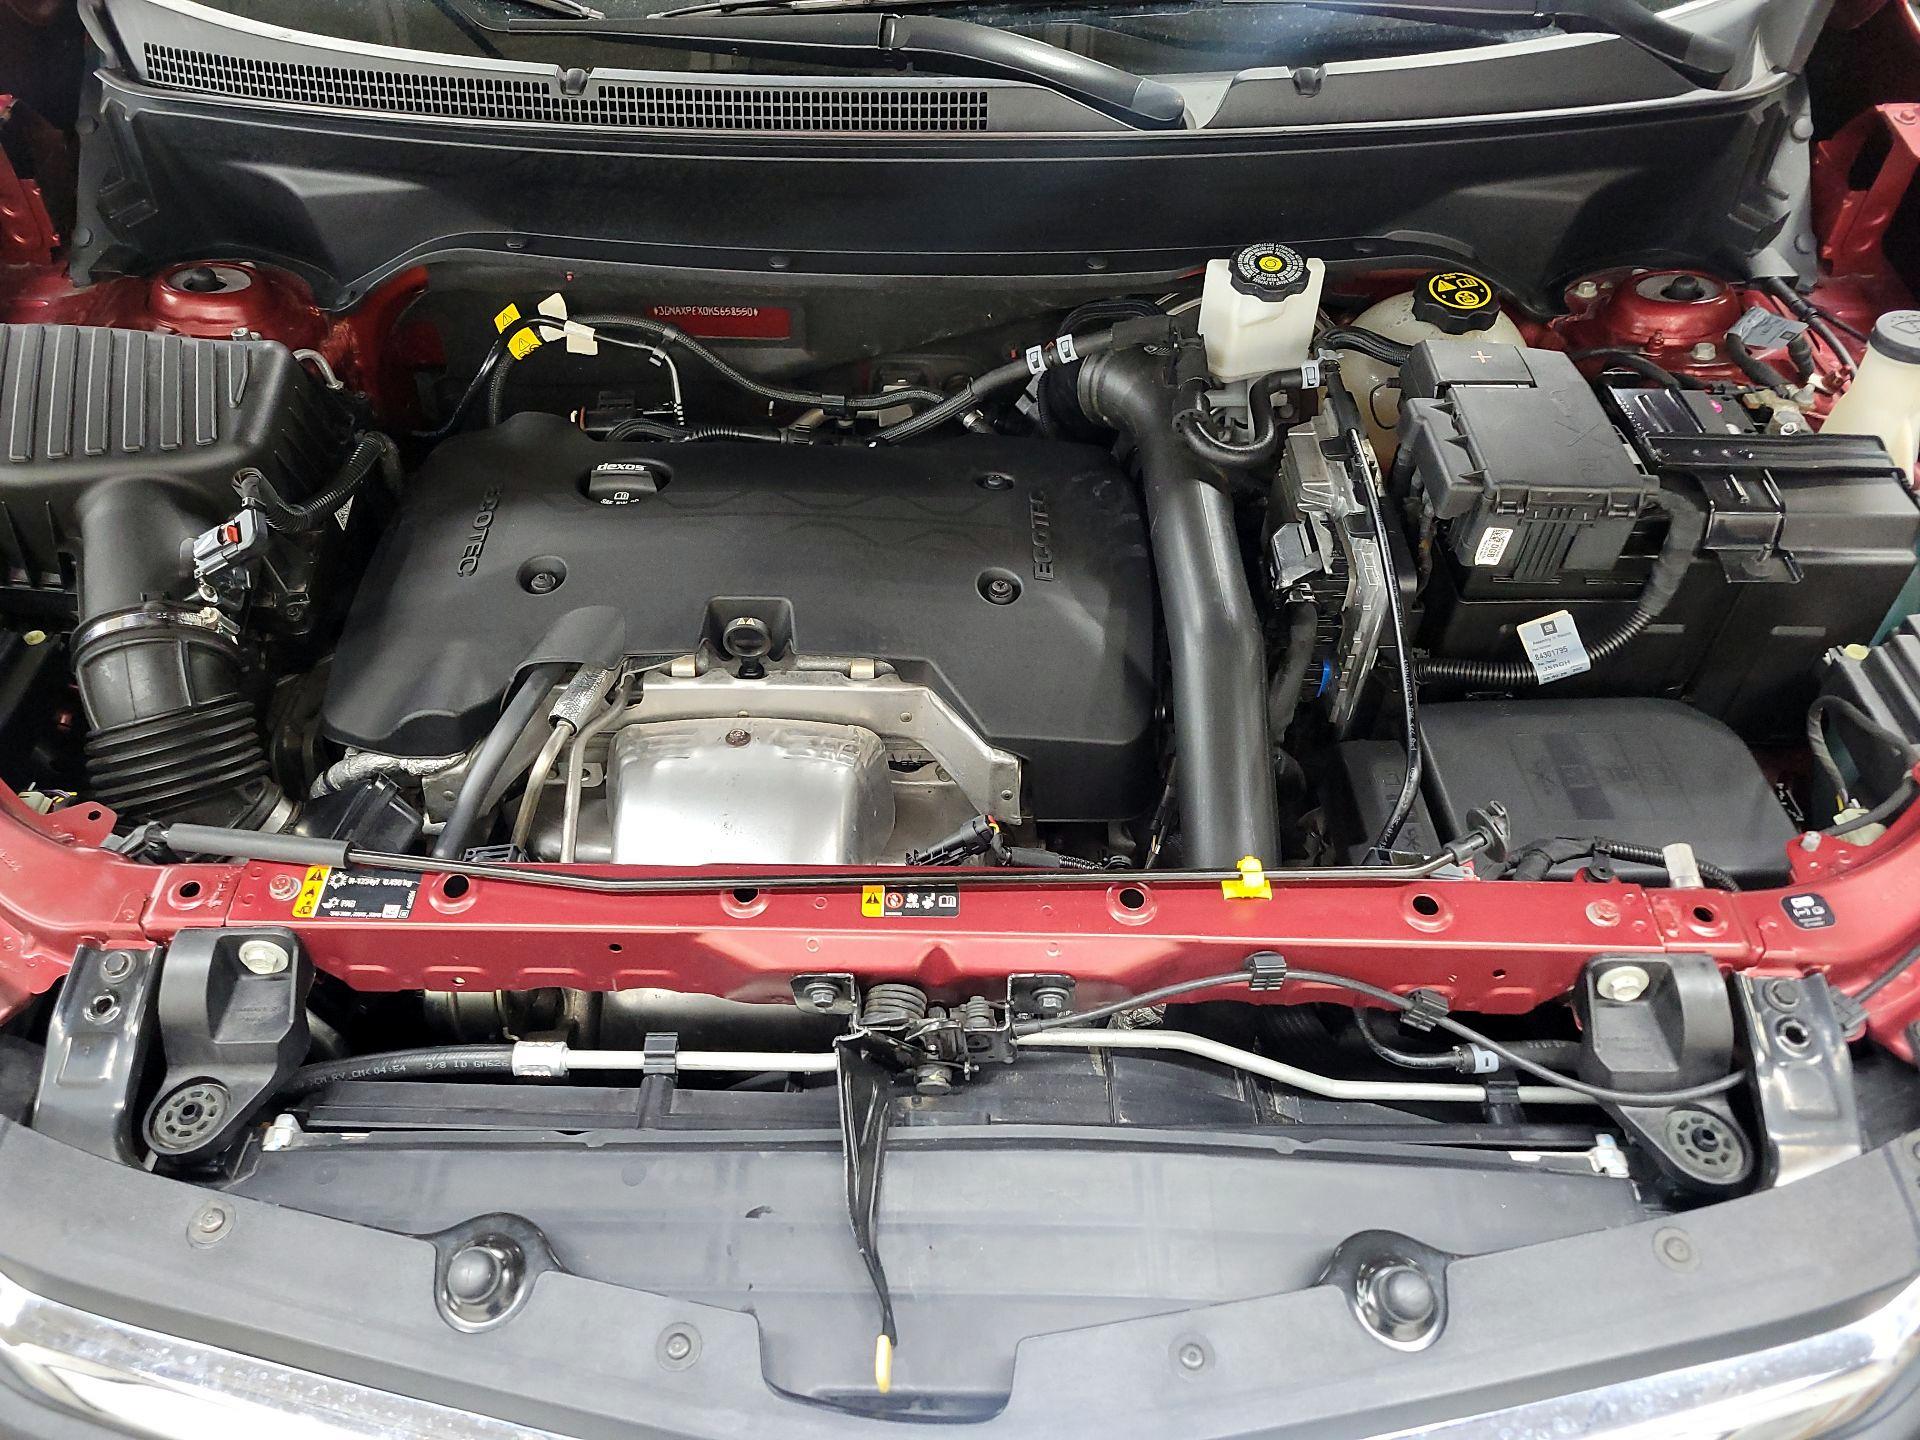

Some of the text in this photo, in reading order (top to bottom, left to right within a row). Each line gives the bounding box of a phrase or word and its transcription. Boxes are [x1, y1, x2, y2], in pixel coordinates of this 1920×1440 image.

[597, 463, 647, 471] dexos
[1534, 645, 1568, 661] 84301795
[425, 1061, 447, 1070] 3/8
